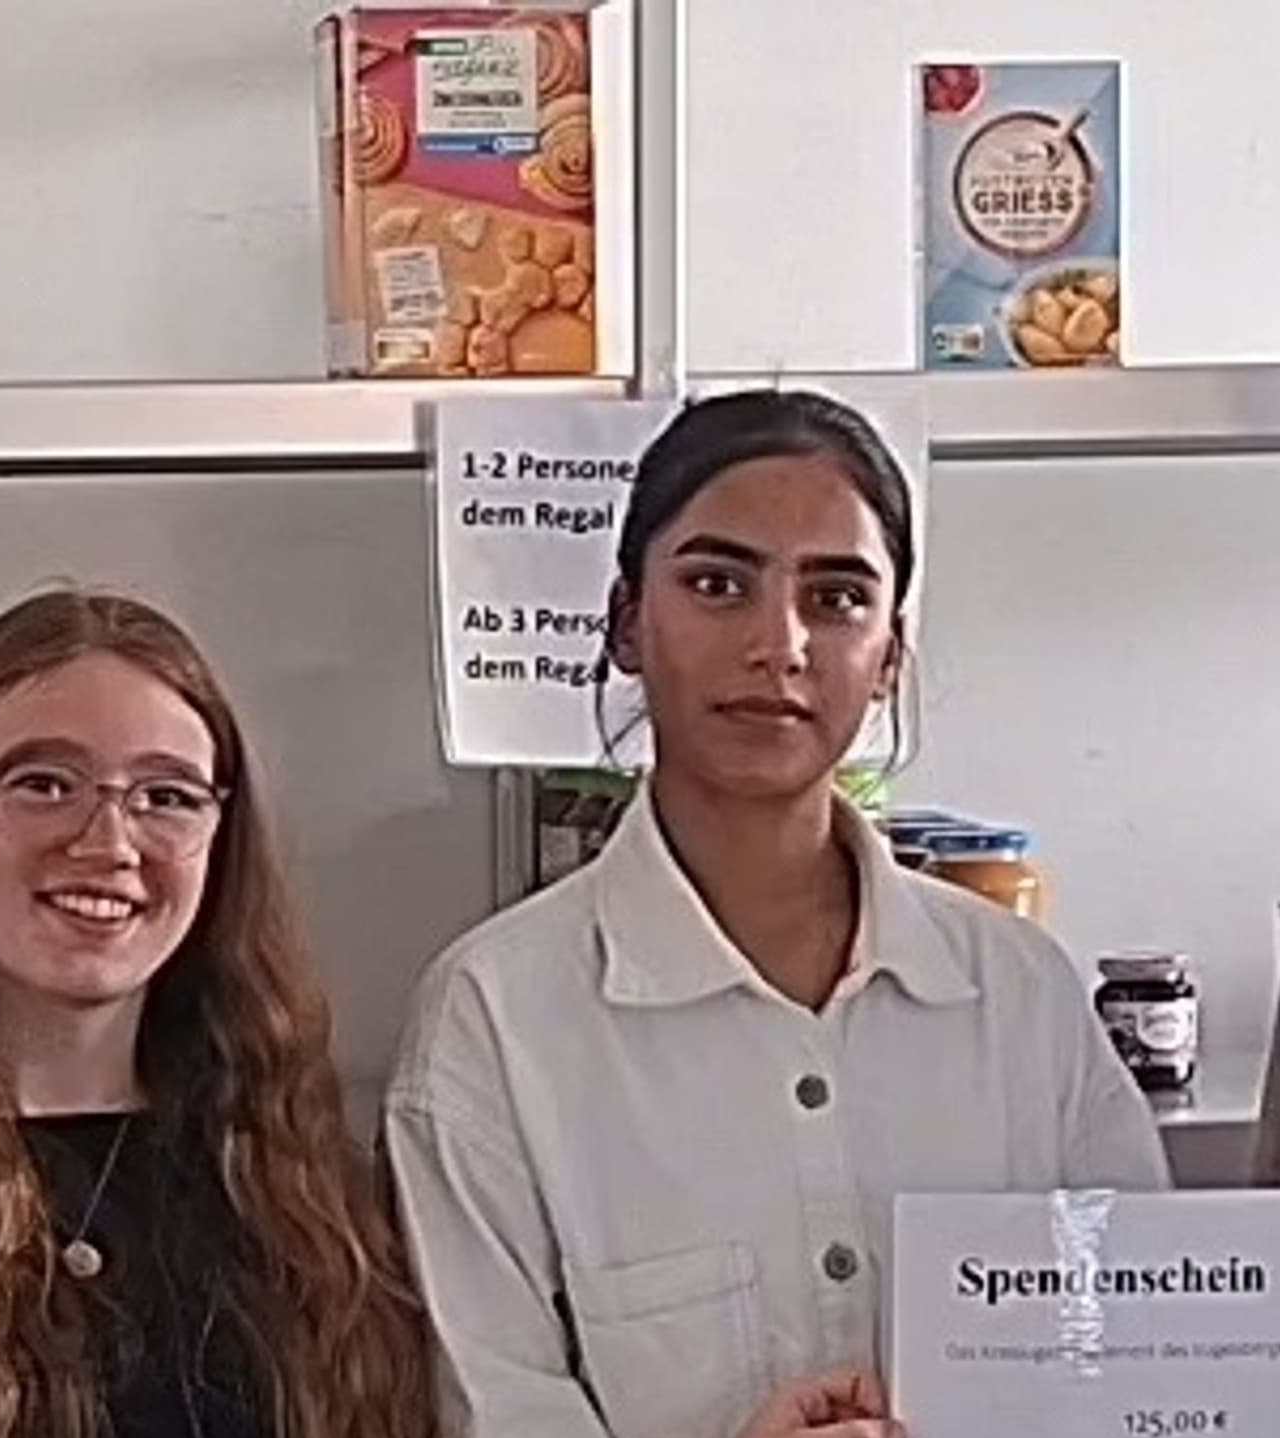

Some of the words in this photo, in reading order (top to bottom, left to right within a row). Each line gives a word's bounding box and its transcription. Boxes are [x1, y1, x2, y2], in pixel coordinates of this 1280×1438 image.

[971, 189, 1074, 214] GRIESS
[463, 452, 507, 478] 1-2
[517, 453, 638, 482] Persone
[462, 499, 524, 525] dem
[535, 502, 614, 534] Regal
[463, 605, 502, 632] Ab
[510, 608, 525, 632] 3
[464, 652, 526, 679] dem
[957, 1256, 1266, 1305] Spendenschein
[1123, 1410, 1208, 1438] 125,00
